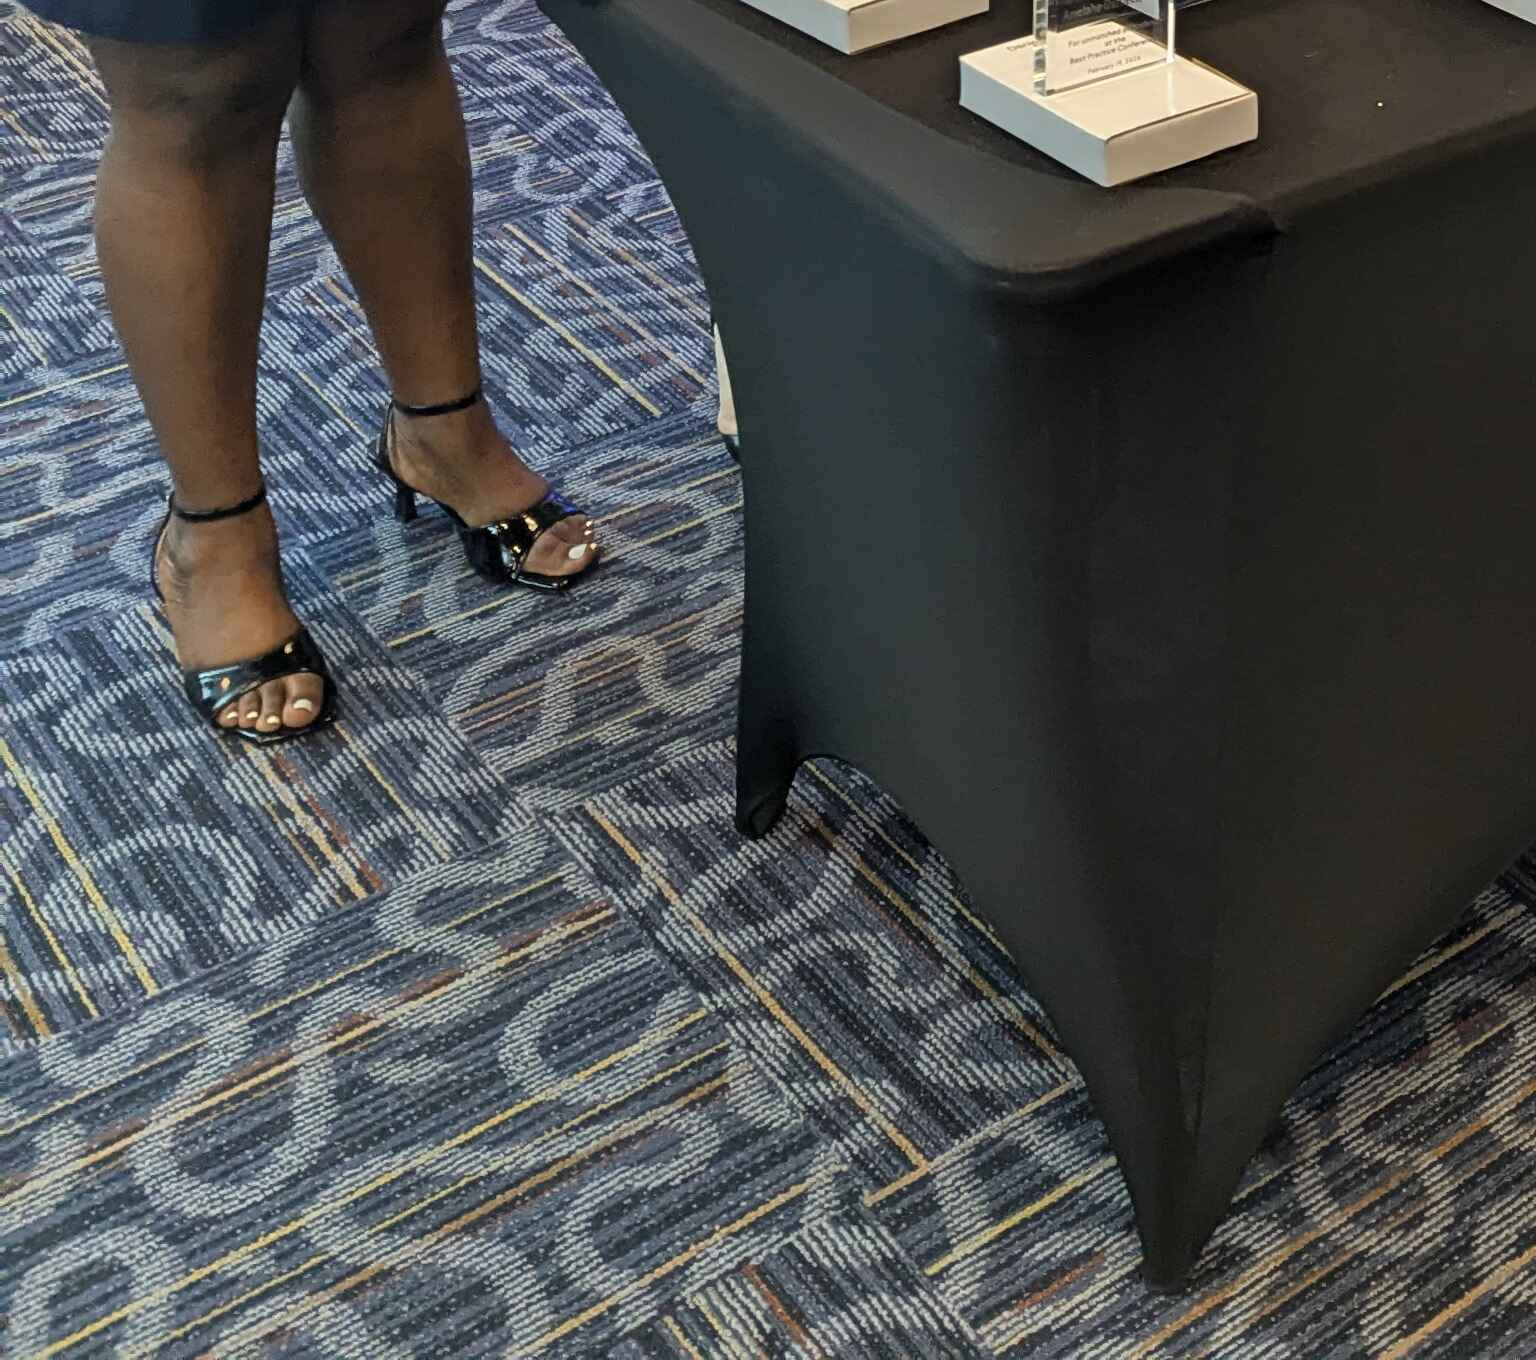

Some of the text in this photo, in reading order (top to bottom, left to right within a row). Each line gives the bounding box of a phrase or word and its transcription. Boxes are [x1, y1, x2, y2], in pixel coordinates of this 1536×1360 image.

[1082, 29, 1124, 43] unmatched
[1070, 49, 1115, 64] Best Practice
[1088, 63, 1114, 74] February
